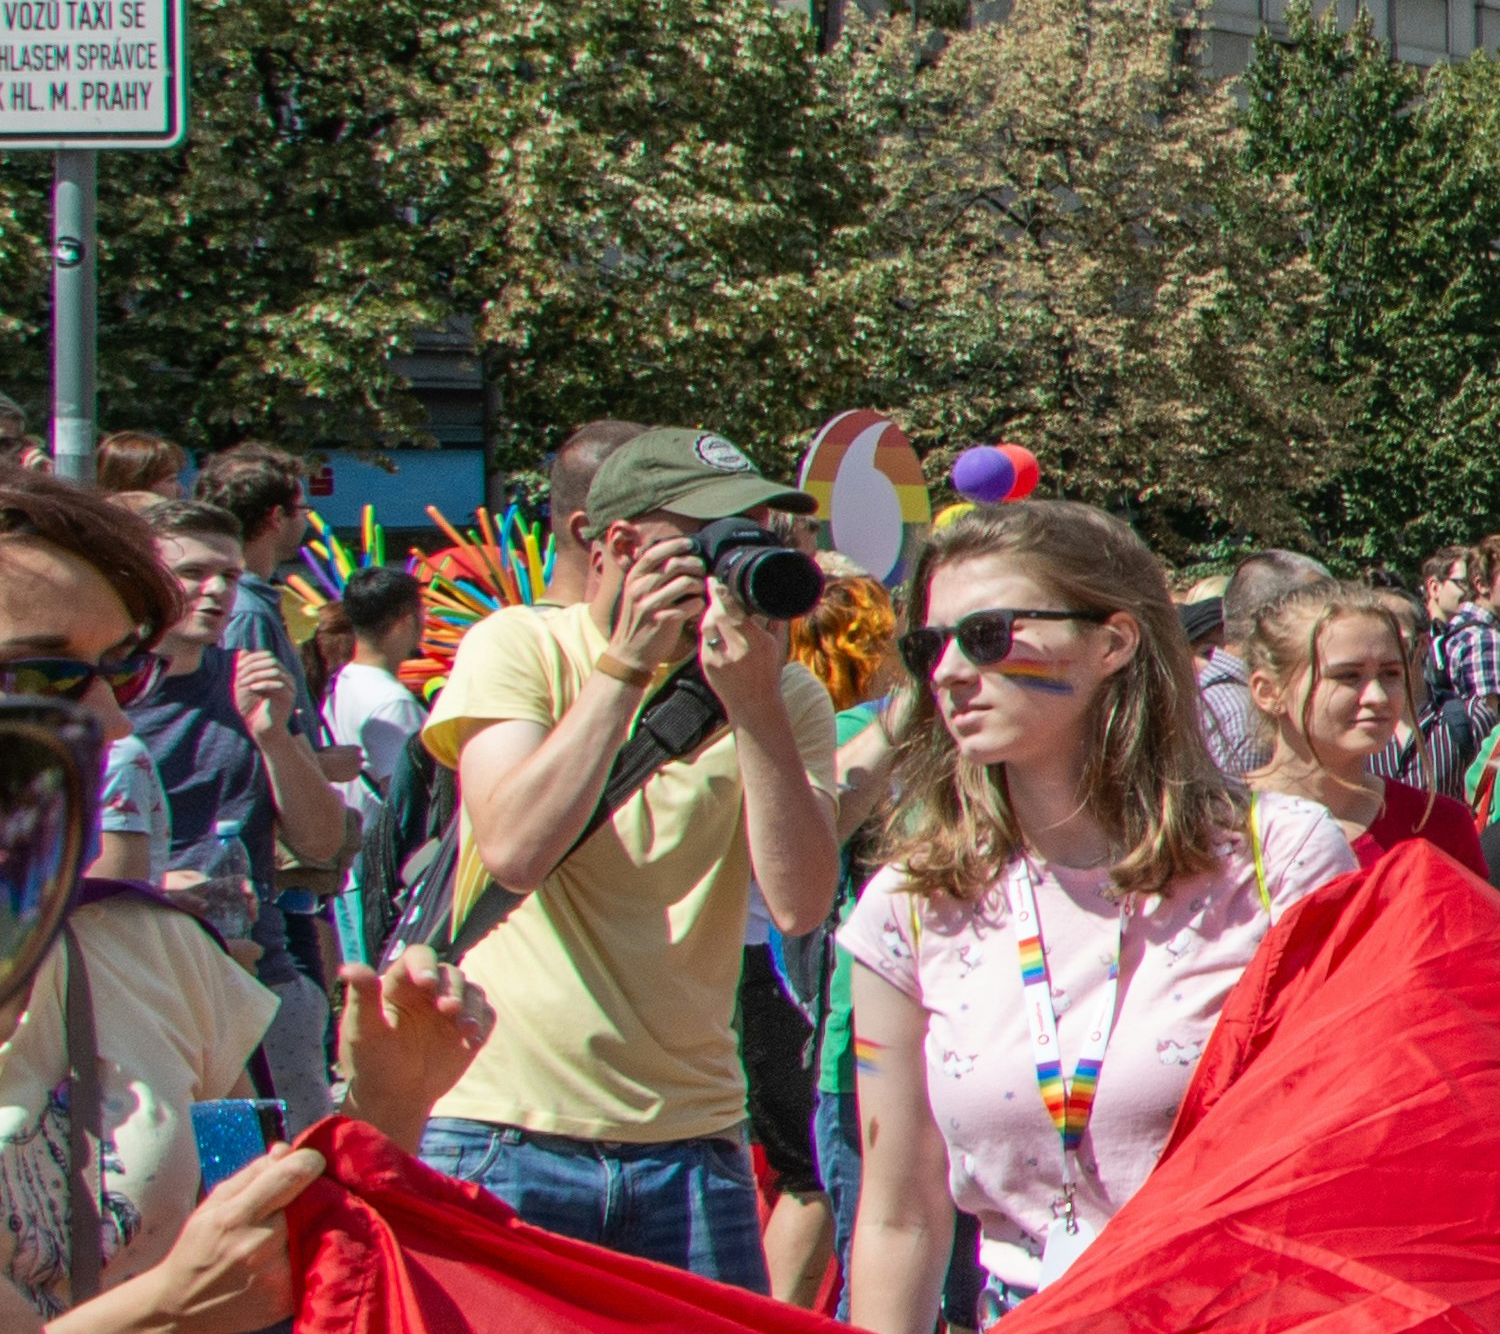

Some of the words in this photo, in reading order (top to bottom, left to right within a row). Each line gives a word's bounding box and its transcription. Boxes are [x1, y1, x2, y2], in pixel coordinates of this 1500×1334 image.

[66, 1, 114, 30] TAXI
[120, 0, 147, 28] SE
[77, 36, 158, 71] SPRÁVCE
[12, 81, 44, 111] HL.
[50, 81, 78, 111] M.
[81, 81, 153, 111] PRAHY
